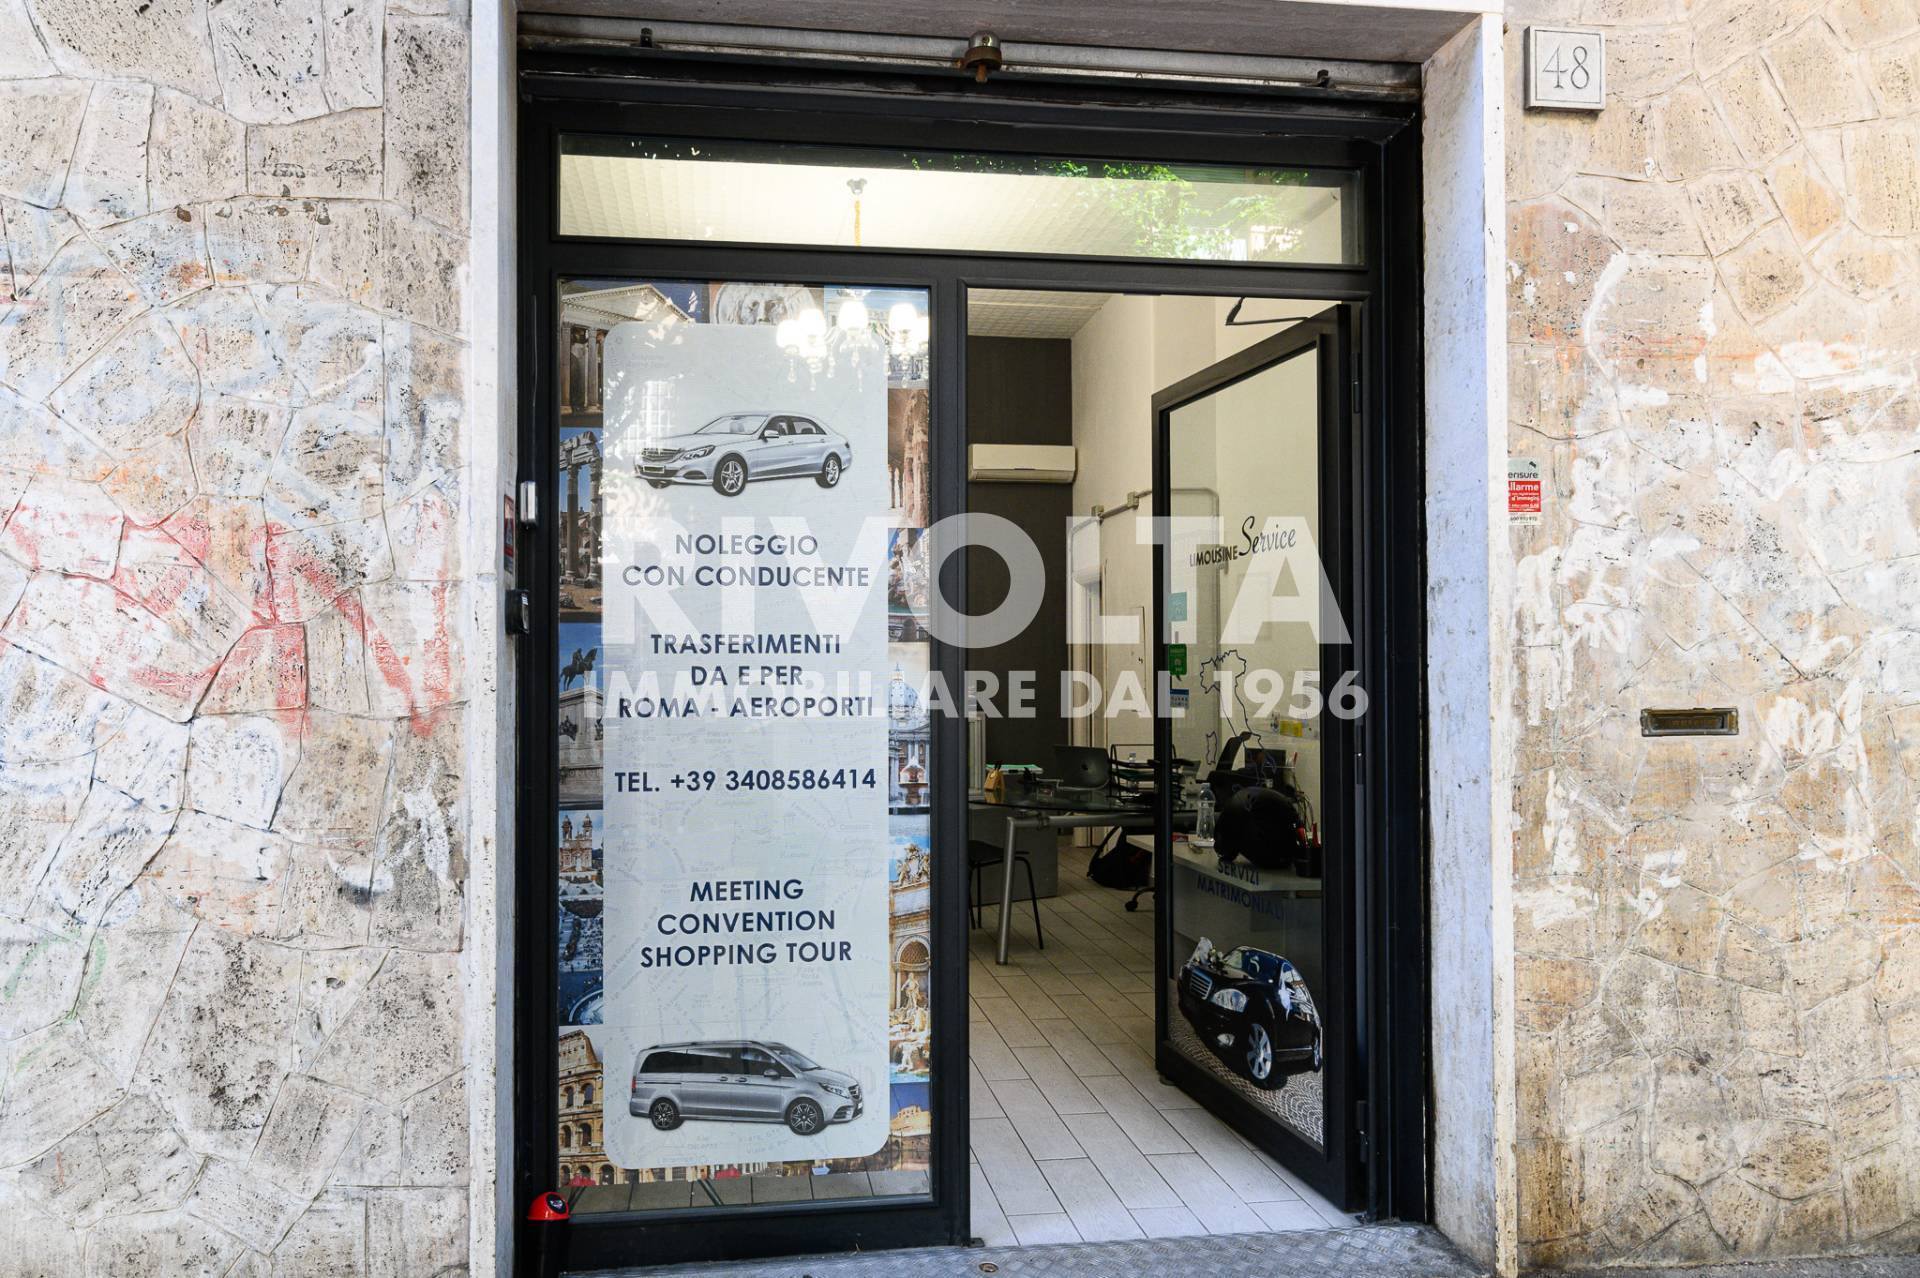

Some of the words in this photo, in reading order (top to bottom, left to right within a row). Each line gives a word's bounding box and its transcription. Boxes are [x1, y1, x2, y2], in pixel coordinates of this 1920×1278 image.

[1542, 45, 1590, 89] 48
[1508, 471, 1539, 479] erisure
[1509, 481, 1539, 491] llarme
[675, 534, 818, 556] NOLEGGIO
[1189, 545, 1238, 567] LIMOUSINE
[1239, 515, 1297, 556] Service
[622, 565, 685, 586] CON
[695, 565, 869, 587] CONDUCENTE
[651, 633, 841, 654] TRASFERIMENTI
[691, 665, 728, 686] DA
[739, 665, 750, 685] E
[760, 665, 803, 685] PER
[618, 697, 701, 718] ROMA
[730, 696, 873, 717] AEROPORTI
[615, 771, 660, 792] TEL.
[670, 770, 716, 792] +39
[725, 768, 877, 791] 3408586414
[1217, 860, 1259, 885] SERVIZI
[690, 879, 804, 902] MEETING
[657, 910, 836, 935] CONVENTION
[640, 943, 777, 968] SHOPPING
[788, 941, 852, 962] TOUR
